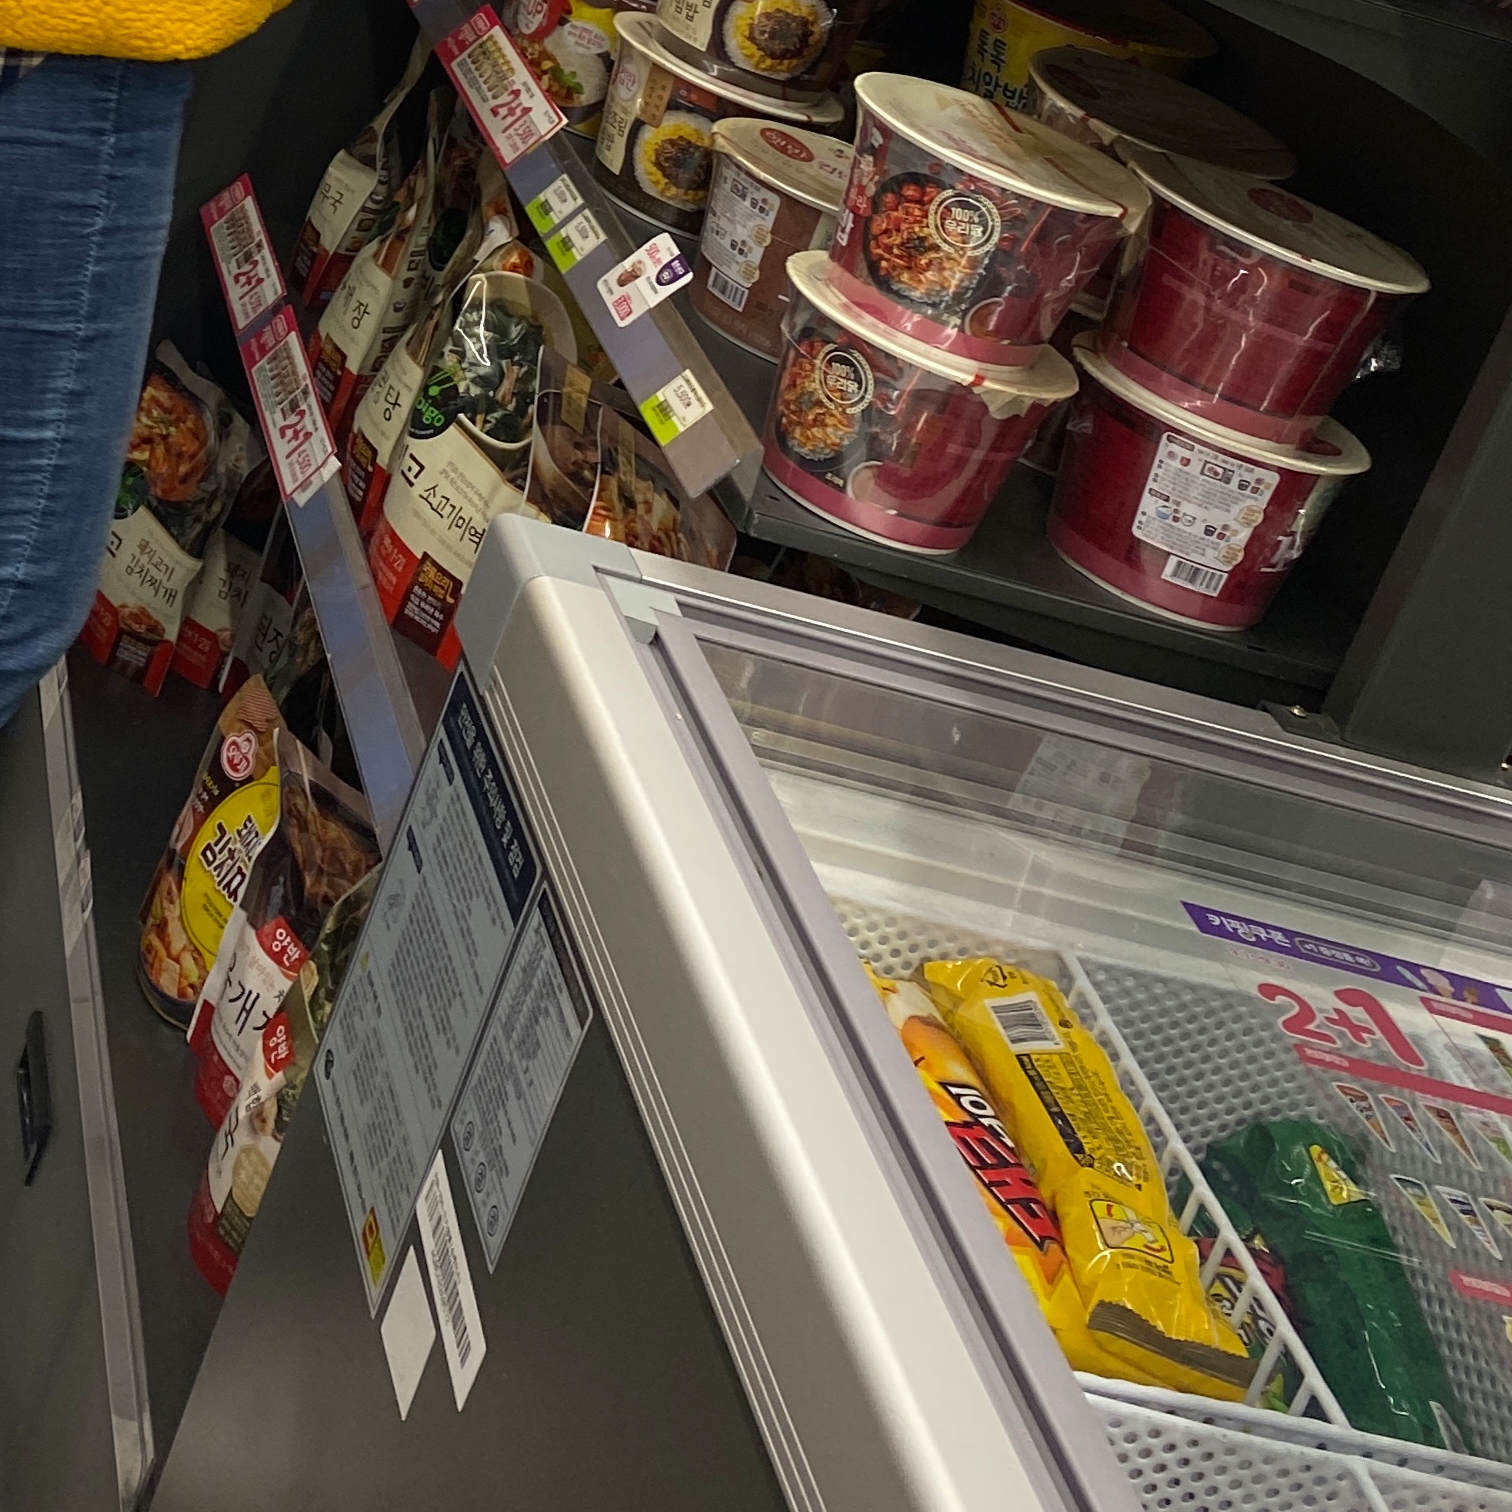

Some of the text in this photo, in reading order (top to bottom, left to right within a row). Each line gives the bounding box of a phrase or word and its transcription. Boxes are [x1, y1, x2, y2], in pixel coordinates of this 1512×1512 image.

[490, 89, 532, 135] 2+1
[951, 205, 979, 225] 100%
[232, 259, 264, 302] 2+1
[279, 408, 313, 460] 2+1
[418, 483, 487, 556] 소고기미역
[124, 553, 179, 609] 김치찌개
[136, 537, 176, 584] 돼지고기
[271, 927, 302, 967] 양반
[268, 1023, 291, 1067] 양반
[1256, 981, 1427, 1070] 2+1
